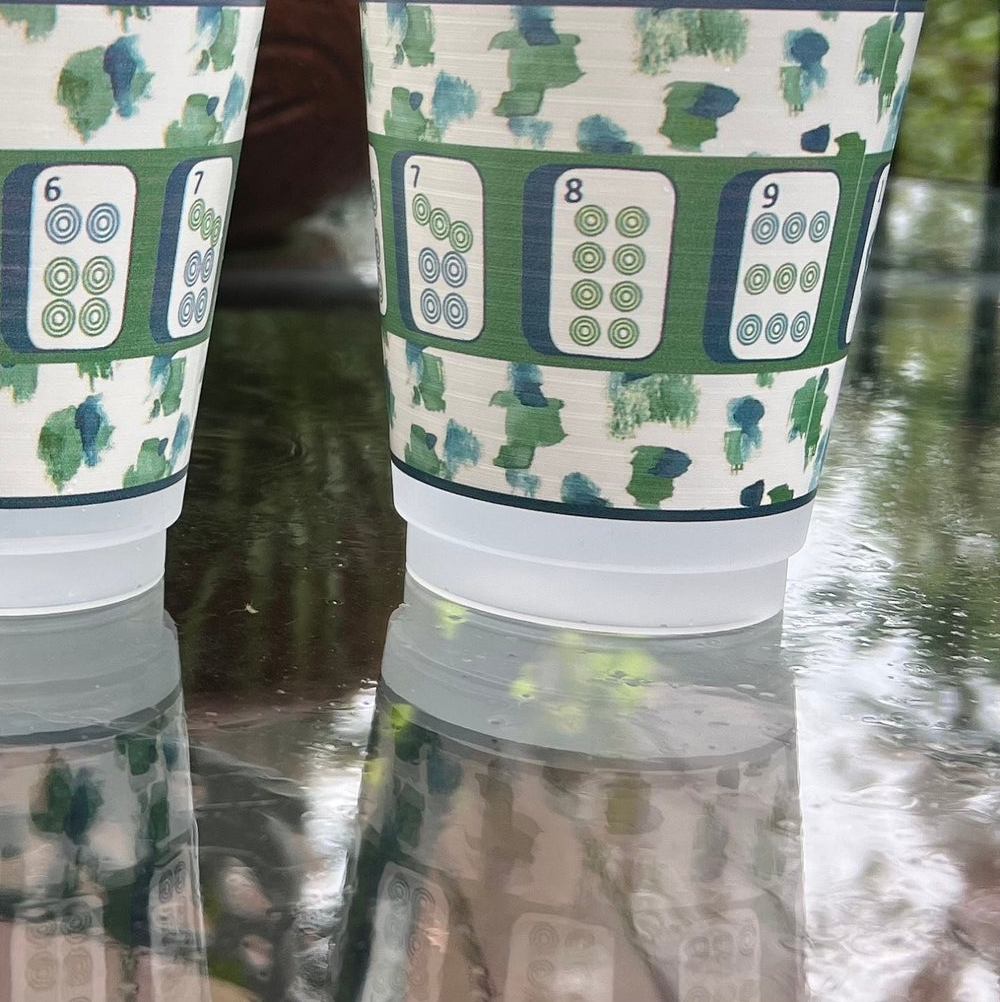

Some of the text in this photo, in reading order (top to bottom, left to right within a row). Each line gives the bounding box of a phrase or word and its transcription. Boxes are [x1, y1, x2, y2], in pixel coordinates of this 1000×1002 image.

[194, 171, 204, 195] 7
[410, 165, 420, 188] 7
[44, 177, 61, 202] 6
[564, 178, 582, 203] 8
[762, 183, 779, 208] 9
